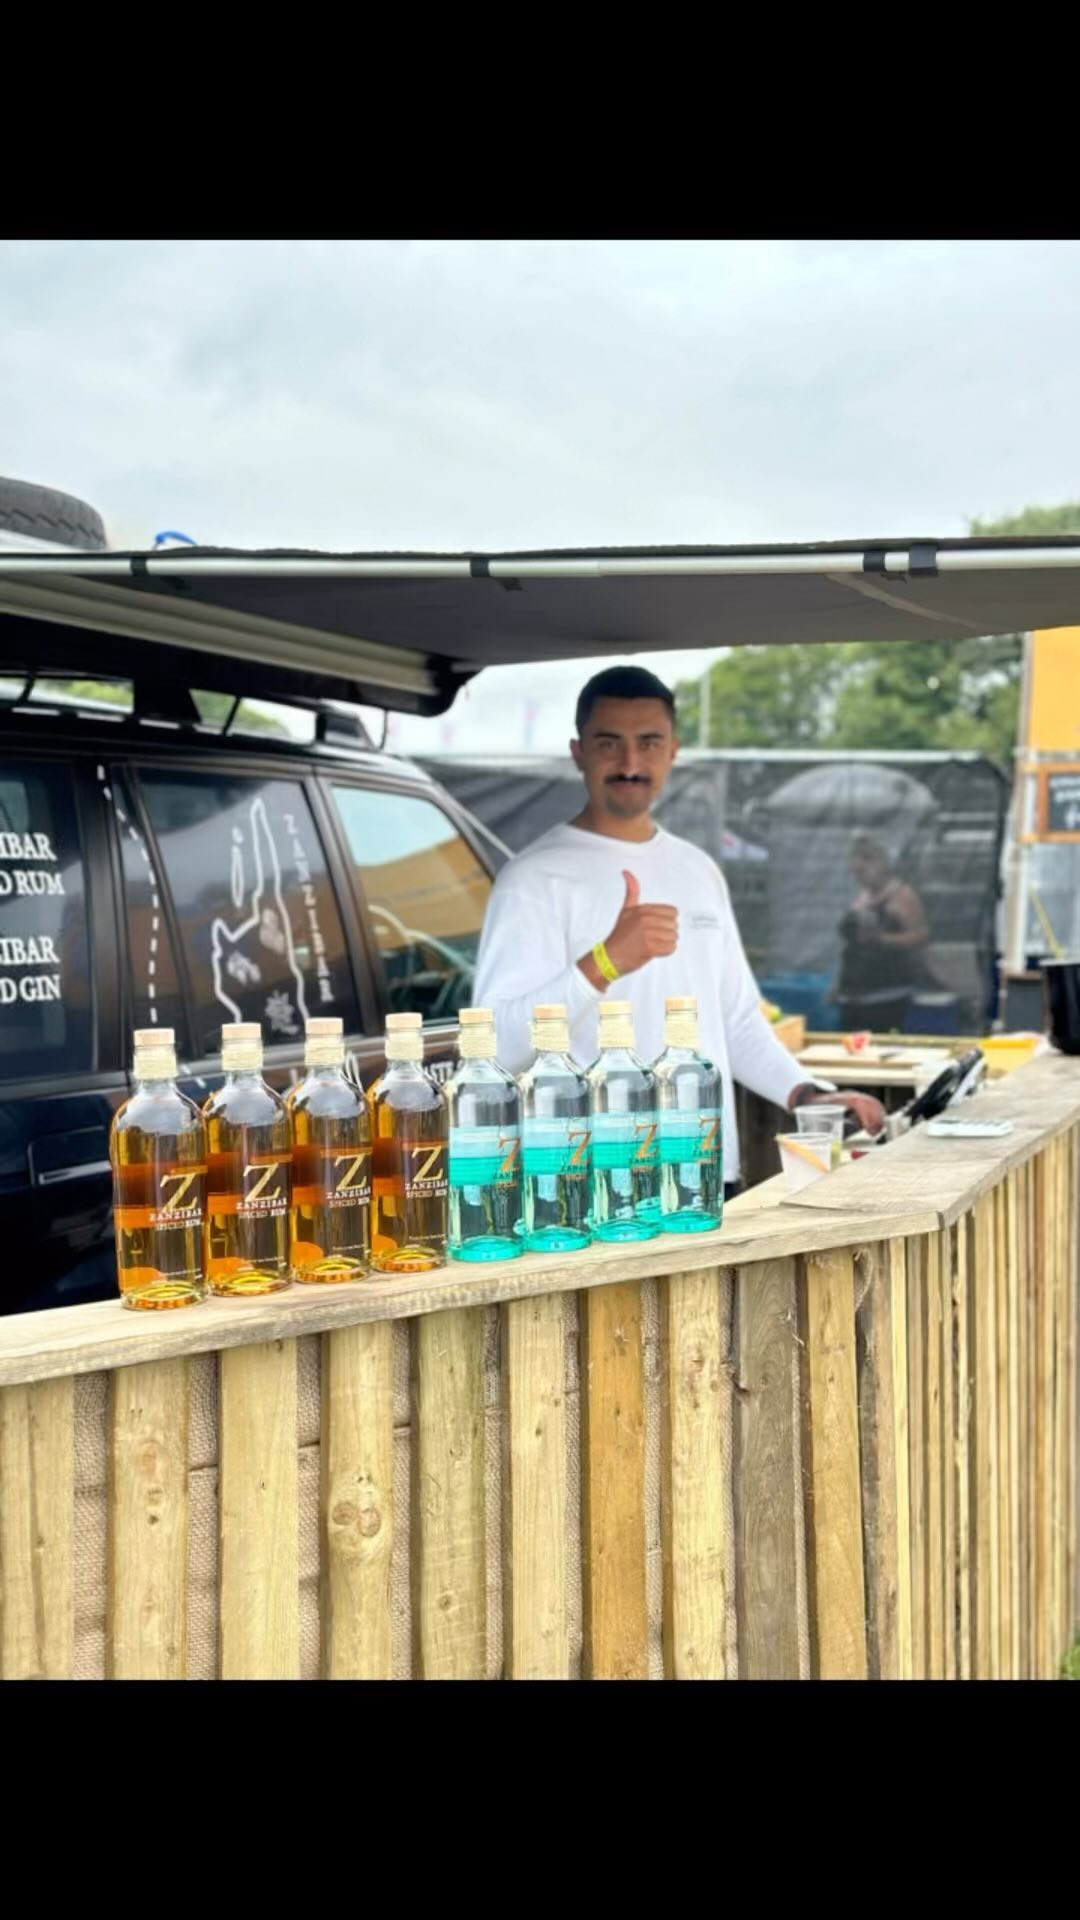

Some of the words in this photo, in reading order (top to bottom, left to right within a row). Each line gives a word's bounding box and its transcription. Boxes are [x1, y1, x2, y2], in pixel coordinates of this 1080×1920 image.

[13, 870, 66, 895] RUM
[19, 974, 62, 1001] GIN
[242, 1162, 282, 1203] Z
[334, 1152, 368, 1193] Z
[411, 1145, 444, 1183] Z
[159, 1172, 199, 1214] Z
